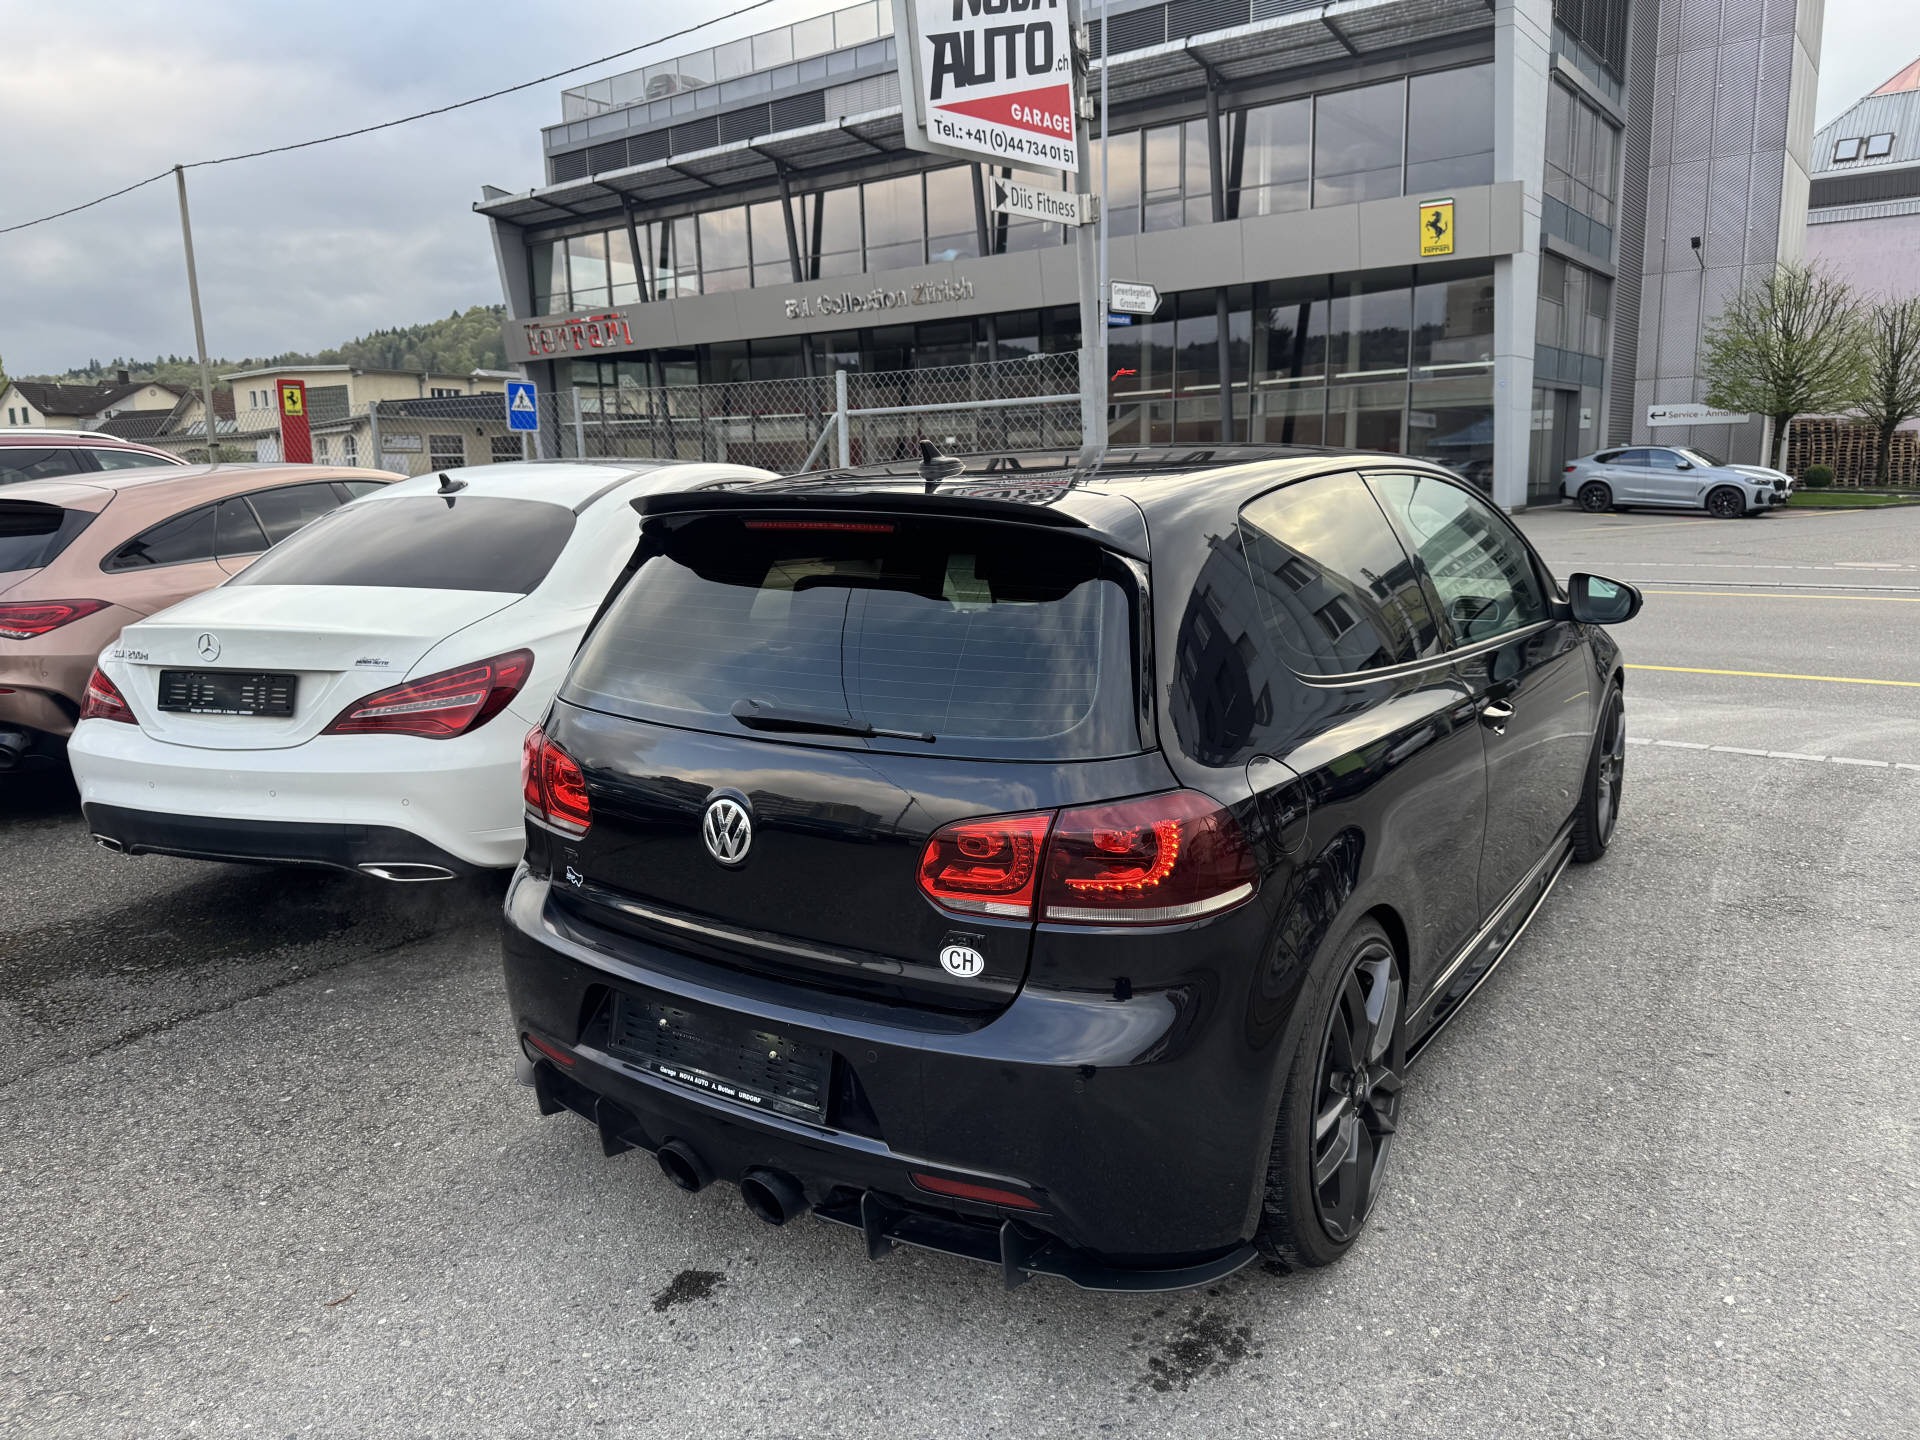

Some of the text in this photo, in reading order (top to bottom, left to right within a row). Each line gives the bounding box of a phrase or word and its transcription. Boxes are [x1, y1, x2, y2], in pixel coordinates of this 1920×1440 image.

[925, 21, 1054, 101] AUTO
[1011, 103, 1070, 134] GARAGE
[934, 119, 963, 140] Tel.:
[965, 128, 987, 146] +41
[1026, 140, 1048, 159] 734
[1063, 149, 1074, 164] 51
[1011, 187, 1075, 218] Diis Fitness
[817, 287, 909, 315] Collection
[911, 275, 976, 306] Zürich
[523, 311, 634, 356] Ferrari
[1668, 410, 1698, 419] Service
[949, 950, 974, 972] CH
[660, 1065, 677, 1077] Garage
[679, 1071, 694, 1082] NOVA
[694, 1077, 709, 1087] AUTO
